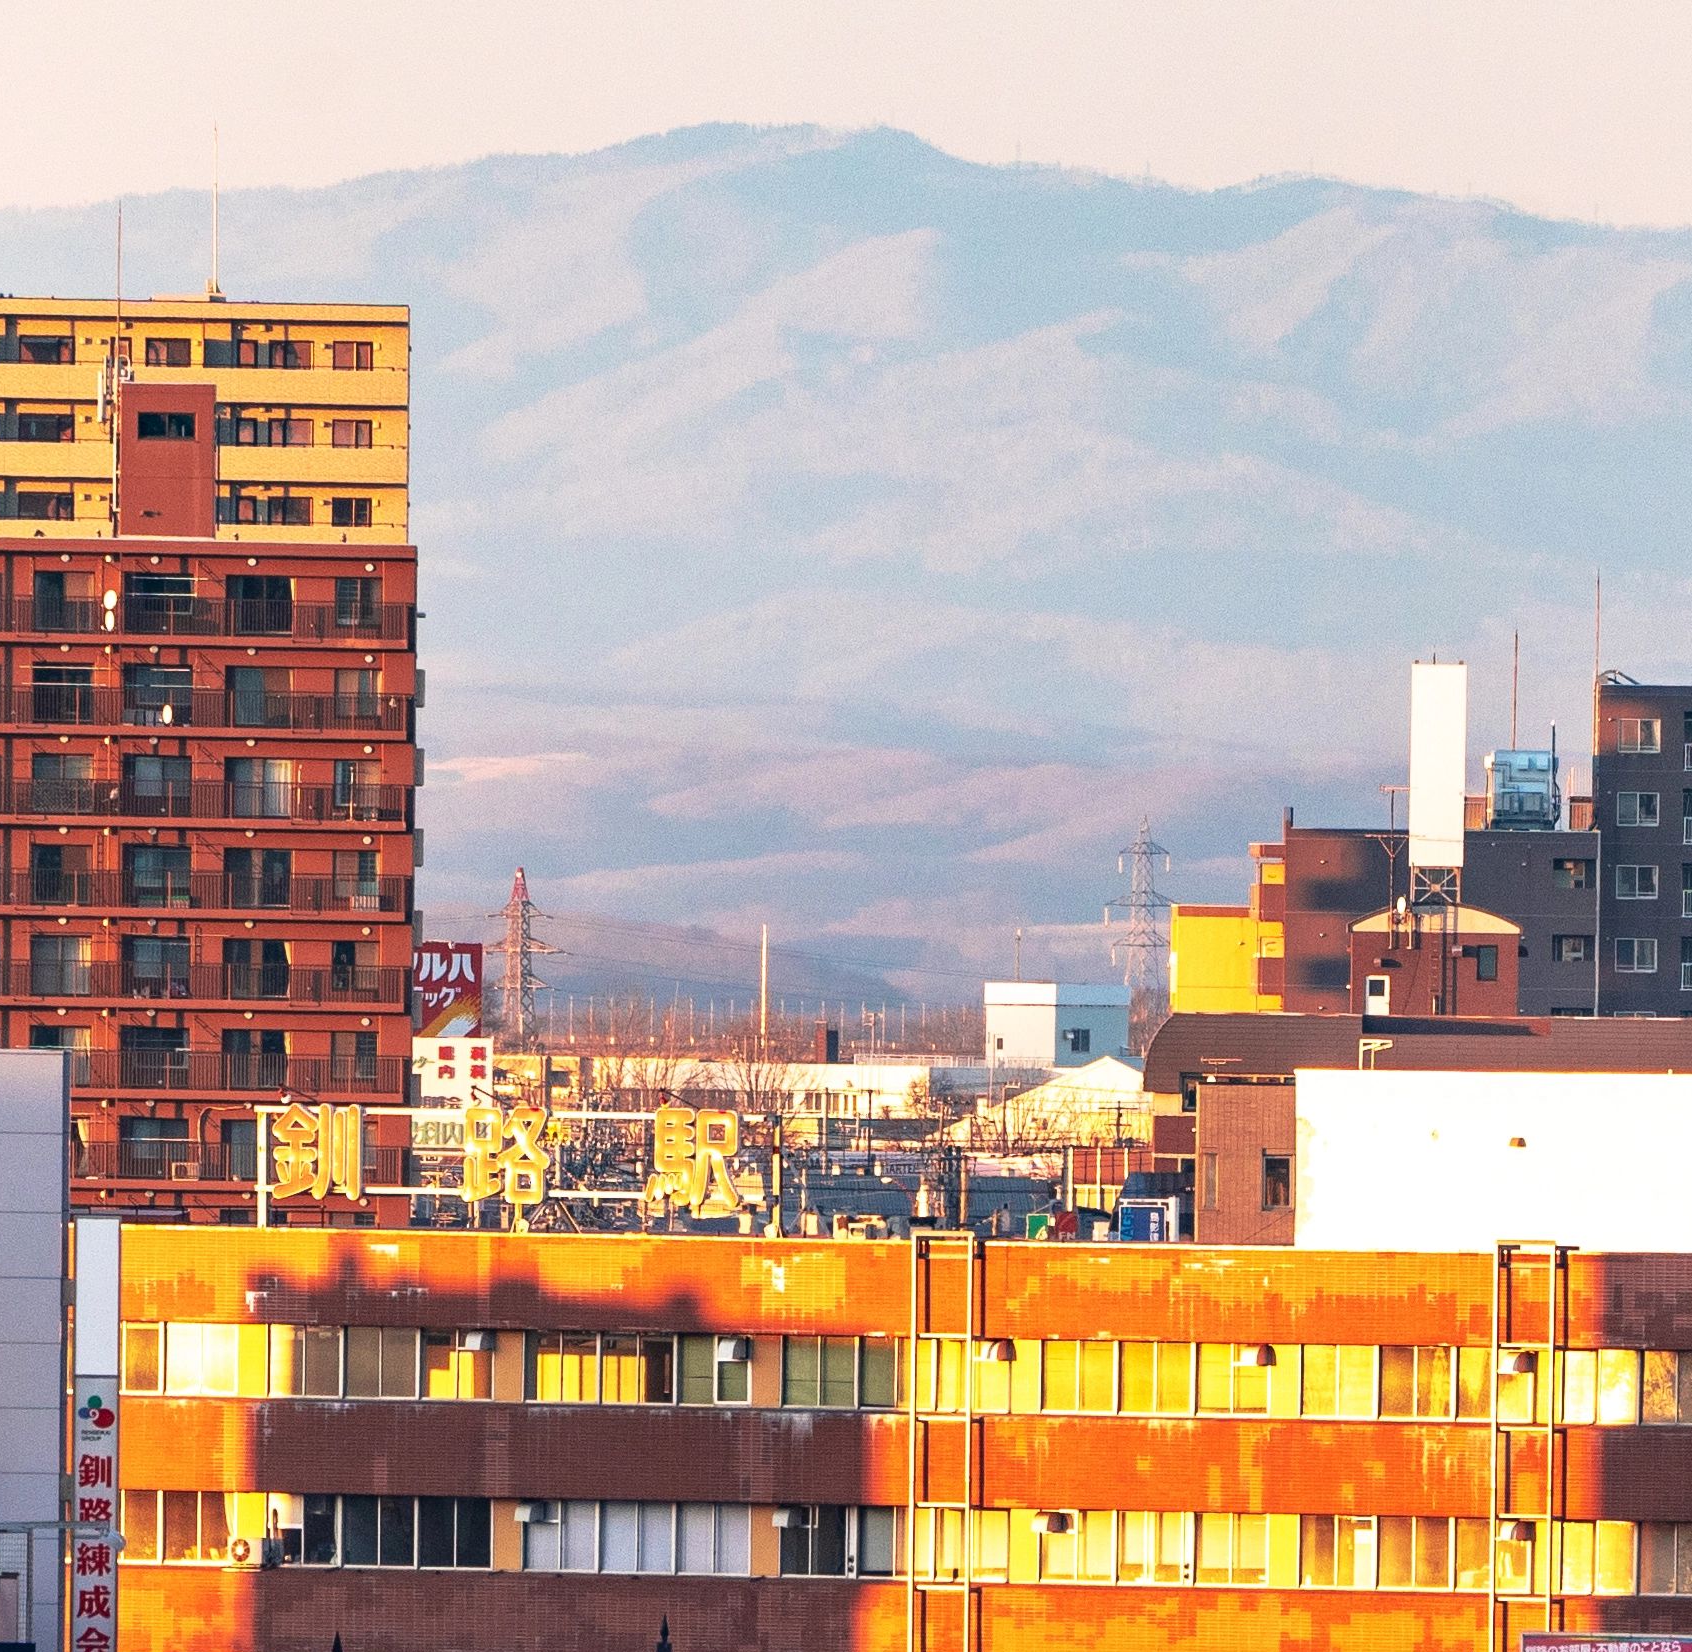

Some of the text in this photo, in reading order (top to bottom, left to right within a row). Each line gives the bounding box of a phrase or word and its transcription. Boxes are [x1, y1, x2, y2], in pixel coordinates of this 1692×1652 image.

[414, 953, 476, 983] ルハ
[270, 1101, 741, 1208] 釧路駅
